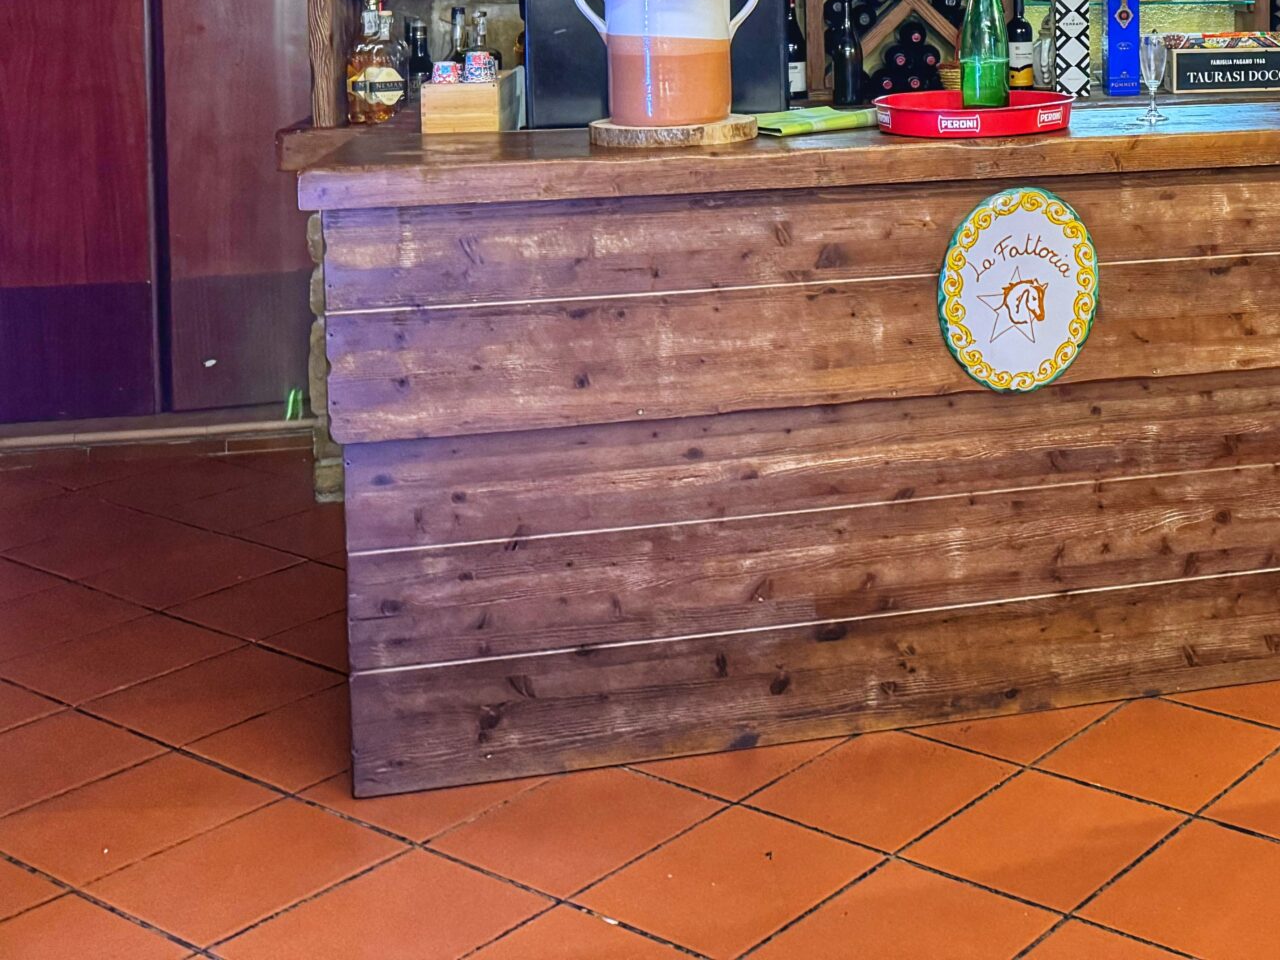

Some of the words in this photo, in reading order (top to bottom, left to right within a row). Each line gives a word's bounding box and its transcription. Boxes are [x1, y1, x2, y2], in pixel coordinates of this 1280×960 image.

[1187, 70, 1245, 84] TAURASI
[1039, 112, 1062, 123] PERONI
[941, 120, 977, 129] PERONI
[967, 258, 996, 282] La
[993, 233, 1072, 279] Fattoria
